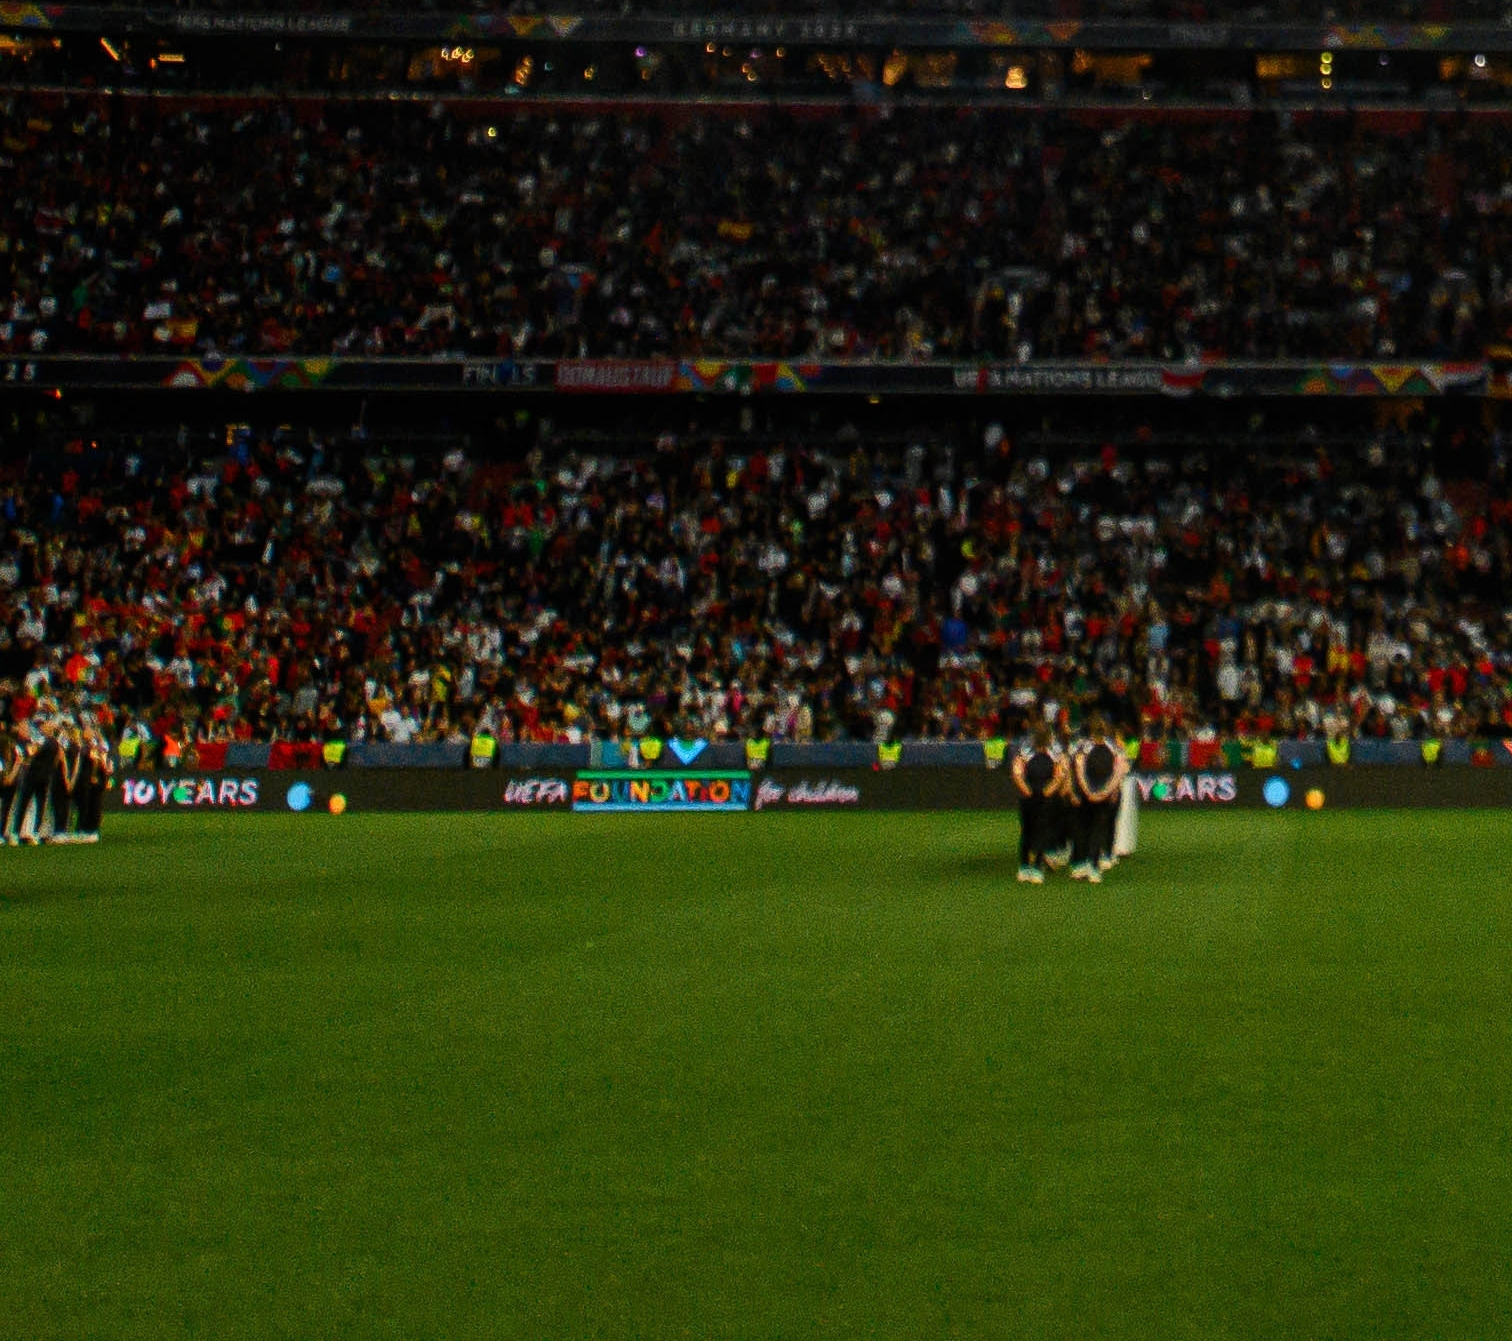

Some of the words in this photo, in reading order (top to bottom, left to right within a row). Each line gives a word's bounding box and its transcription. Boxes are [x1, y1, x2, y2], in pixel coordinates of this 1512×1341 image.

[123, 777, 156, 806] 10
[158, 777, 259, 807] YEARS
[503, 778, 569, 805] UEFA
[572, 777, 751, 805] FOUNDATION
[754, 776, 785, 810] for
[1138, 773, 1237, 804] YEARS
